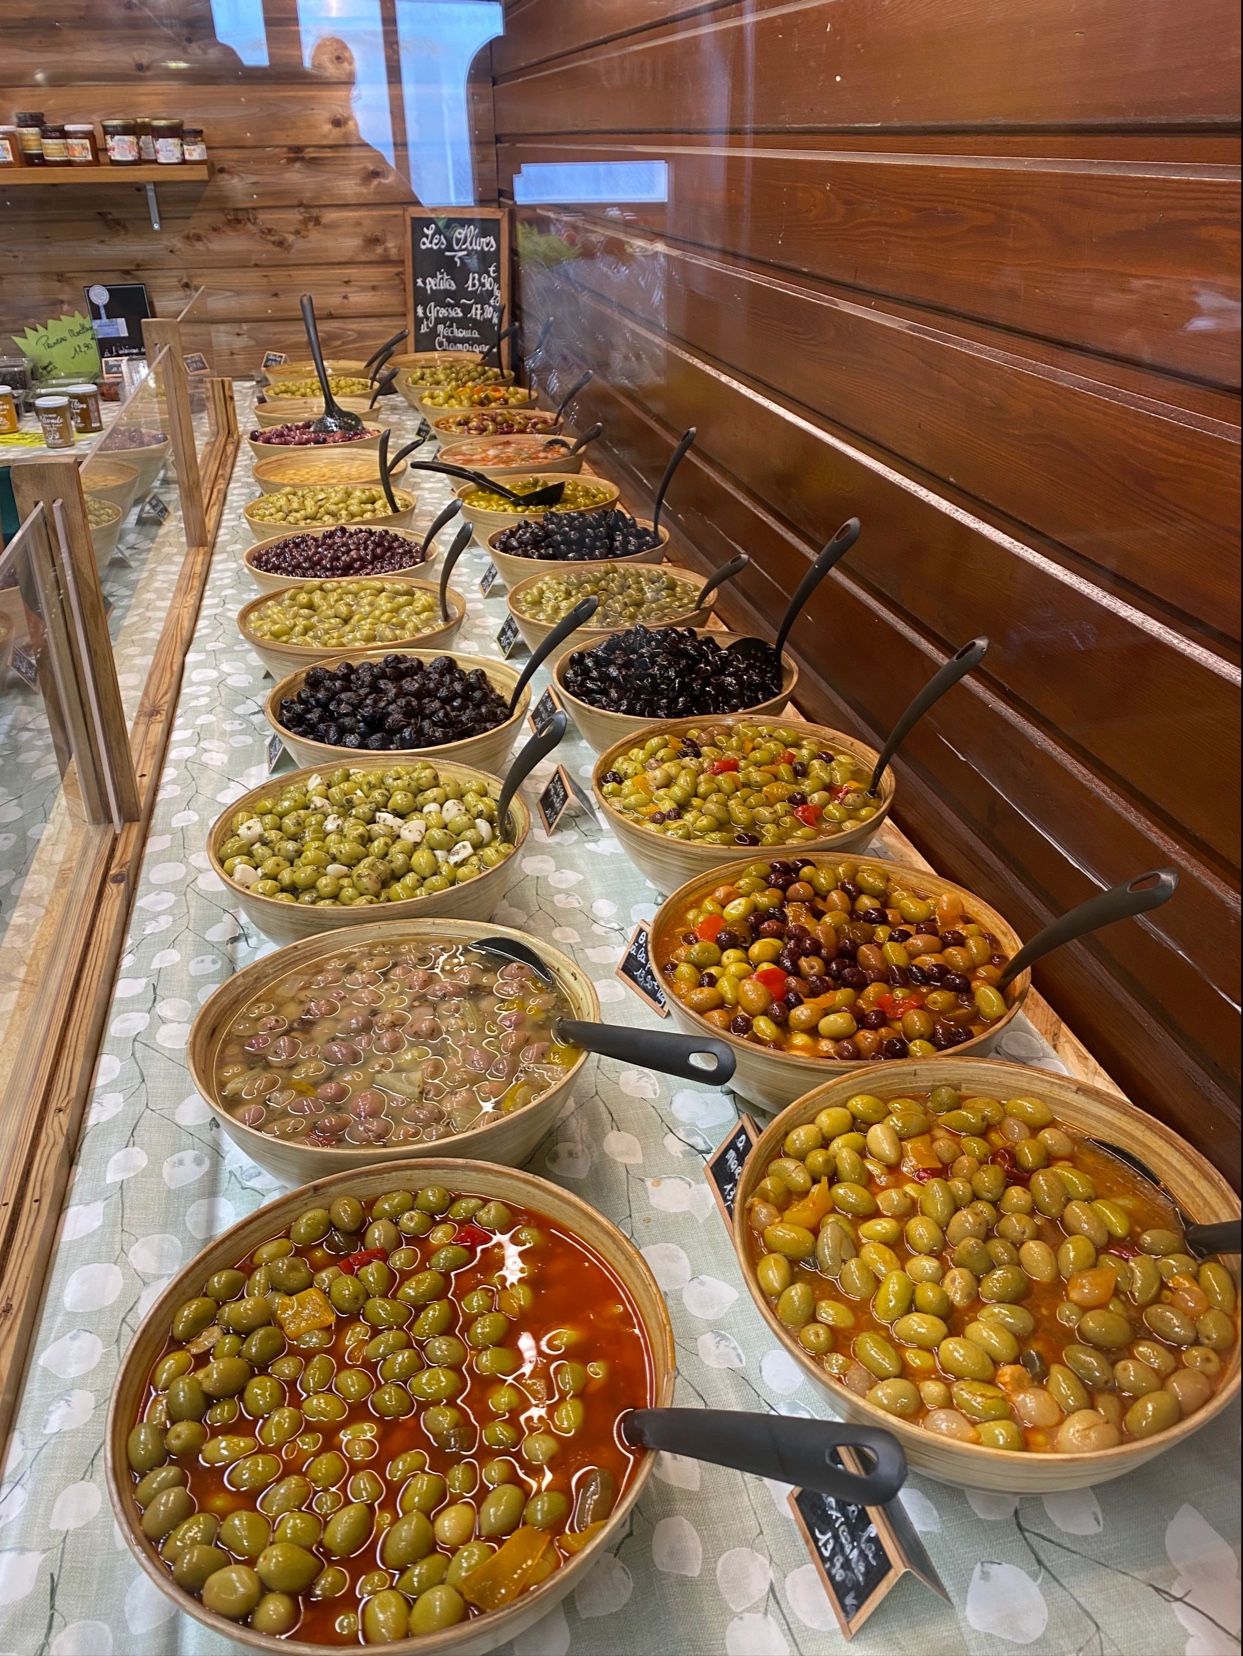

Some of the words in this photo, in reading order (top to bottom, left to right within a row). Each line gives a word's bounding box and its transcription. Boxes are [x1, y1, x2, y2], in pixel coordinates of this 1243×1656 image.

[420, 224, 447, 250] Les
[452, 224, 497, 251] Olives
[426, 269, 457, 294] petites
